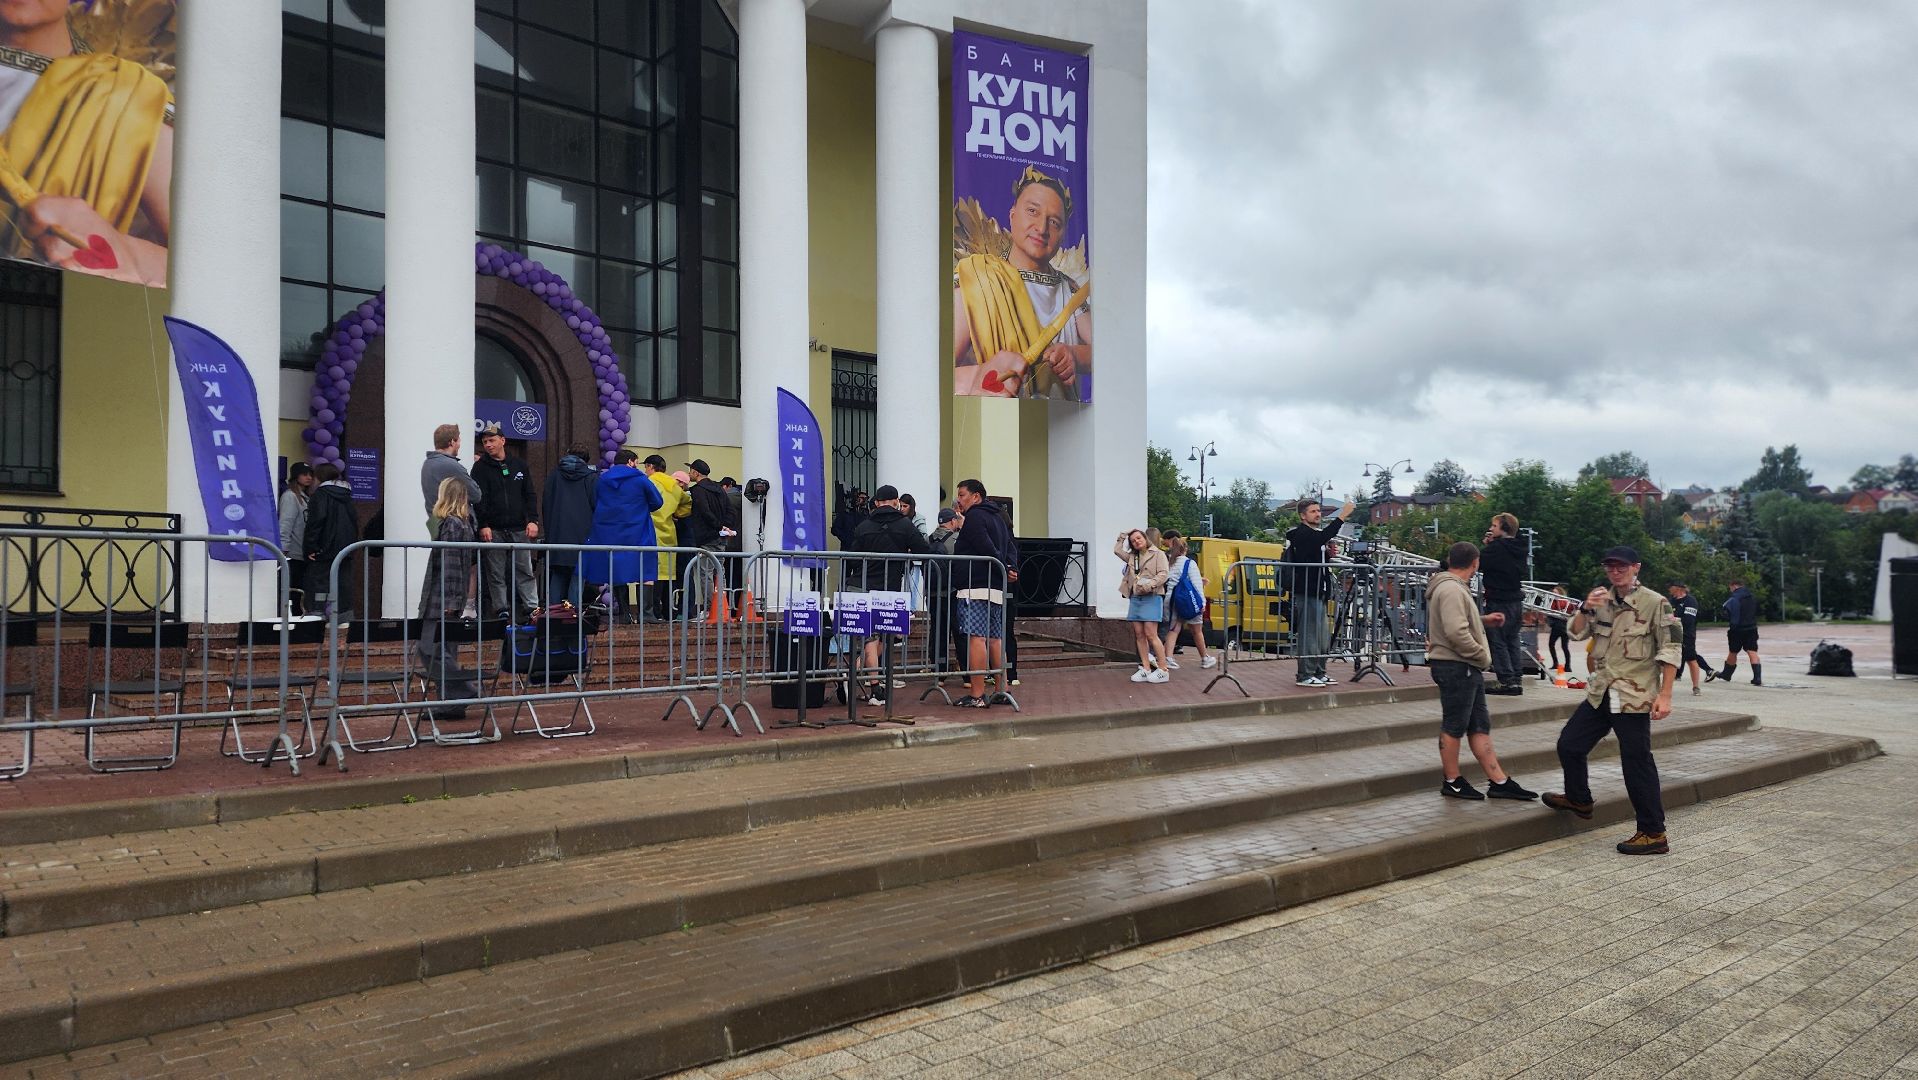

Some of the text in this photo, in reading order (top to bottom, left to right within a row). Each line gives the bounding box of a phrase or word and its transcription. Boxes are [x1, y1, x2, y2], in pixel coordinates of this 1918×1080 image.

[967, 45, 1076, 81] БАНК
[968, 70, 1076, 122] КУПИ
[965, 105, 1076, 162] ДОМ
[840, 626, 865, 634] ЕРСОНАЛА
[874, 624, 902, 632] ПЕРСОНАЛА
